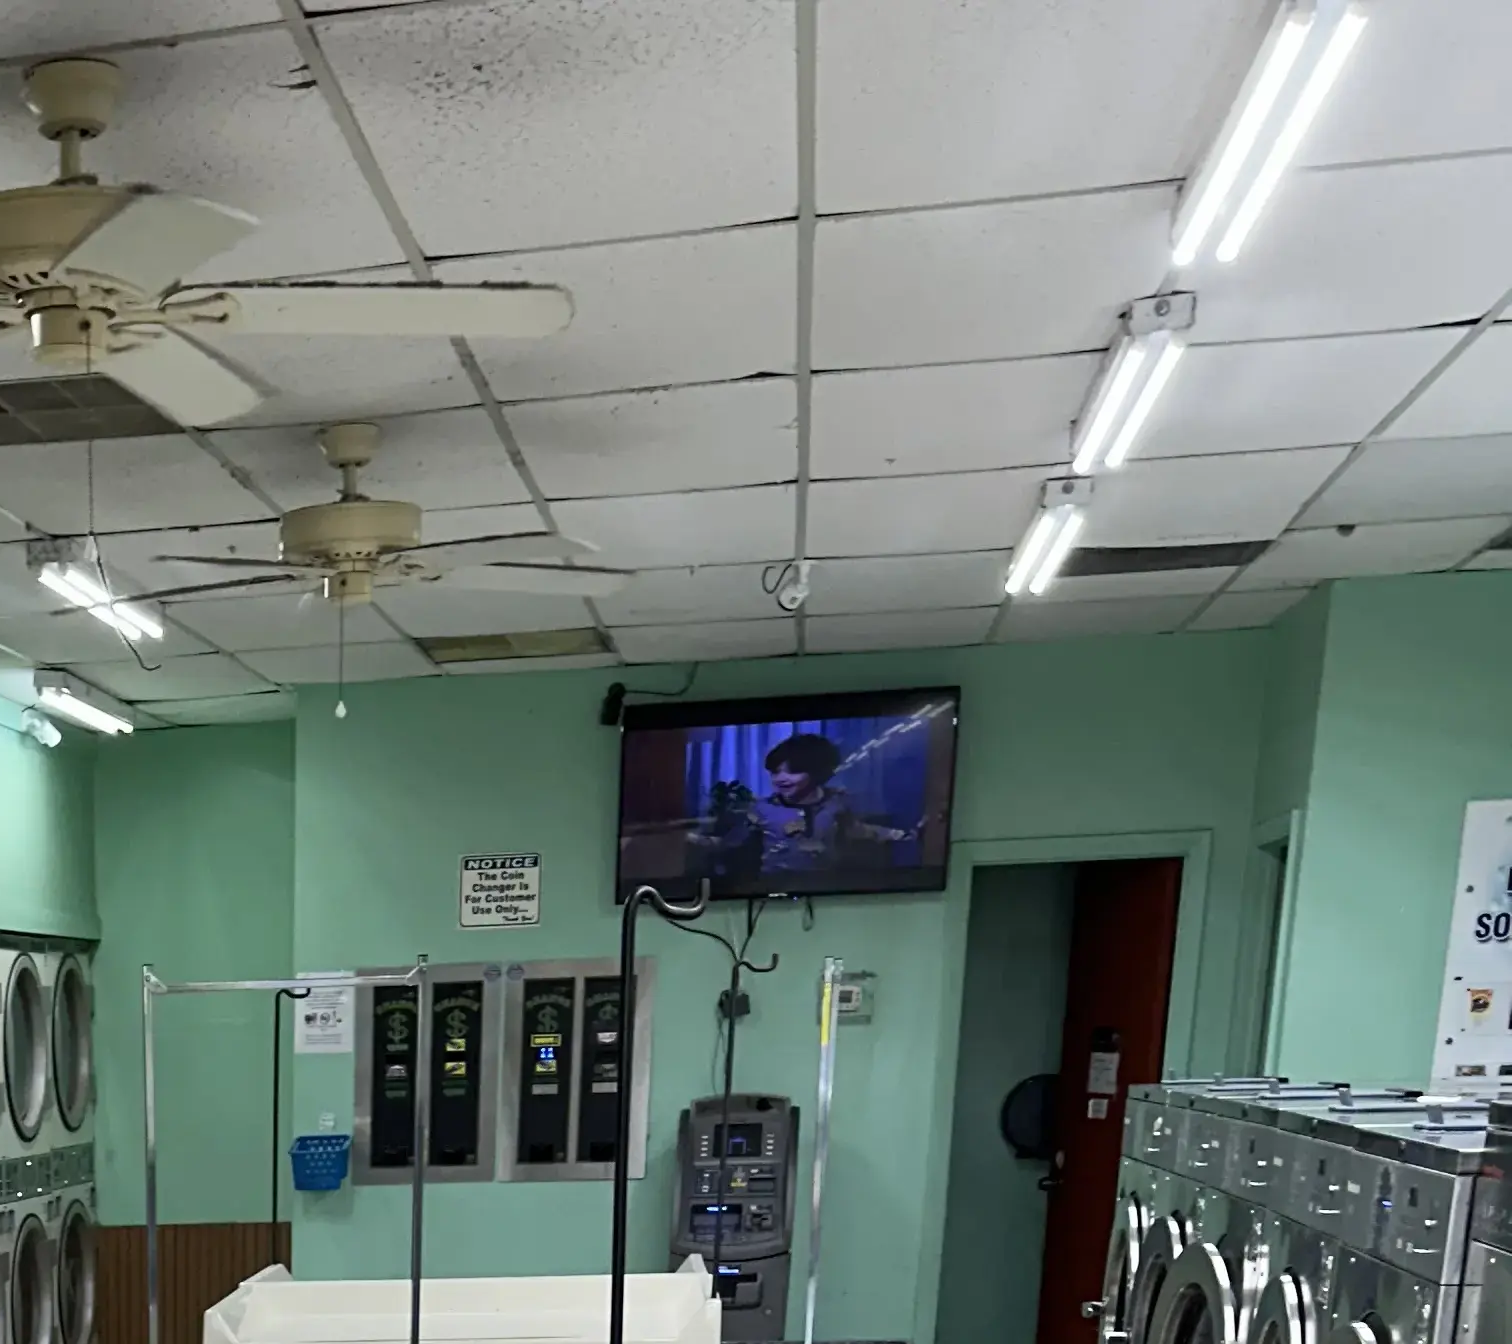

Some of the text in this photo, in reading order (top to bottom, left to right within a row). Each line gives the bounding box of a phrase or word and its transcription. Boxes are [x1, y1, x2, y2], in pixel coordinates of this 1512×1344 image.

[467, 857, 535, 869] NOTICE
[477, 871, 524, 881] The Coin
[472, 883, 516, 893] Changer
[464, 894, 536, 904] For Customer
[472, 906, 492, 914] Use
